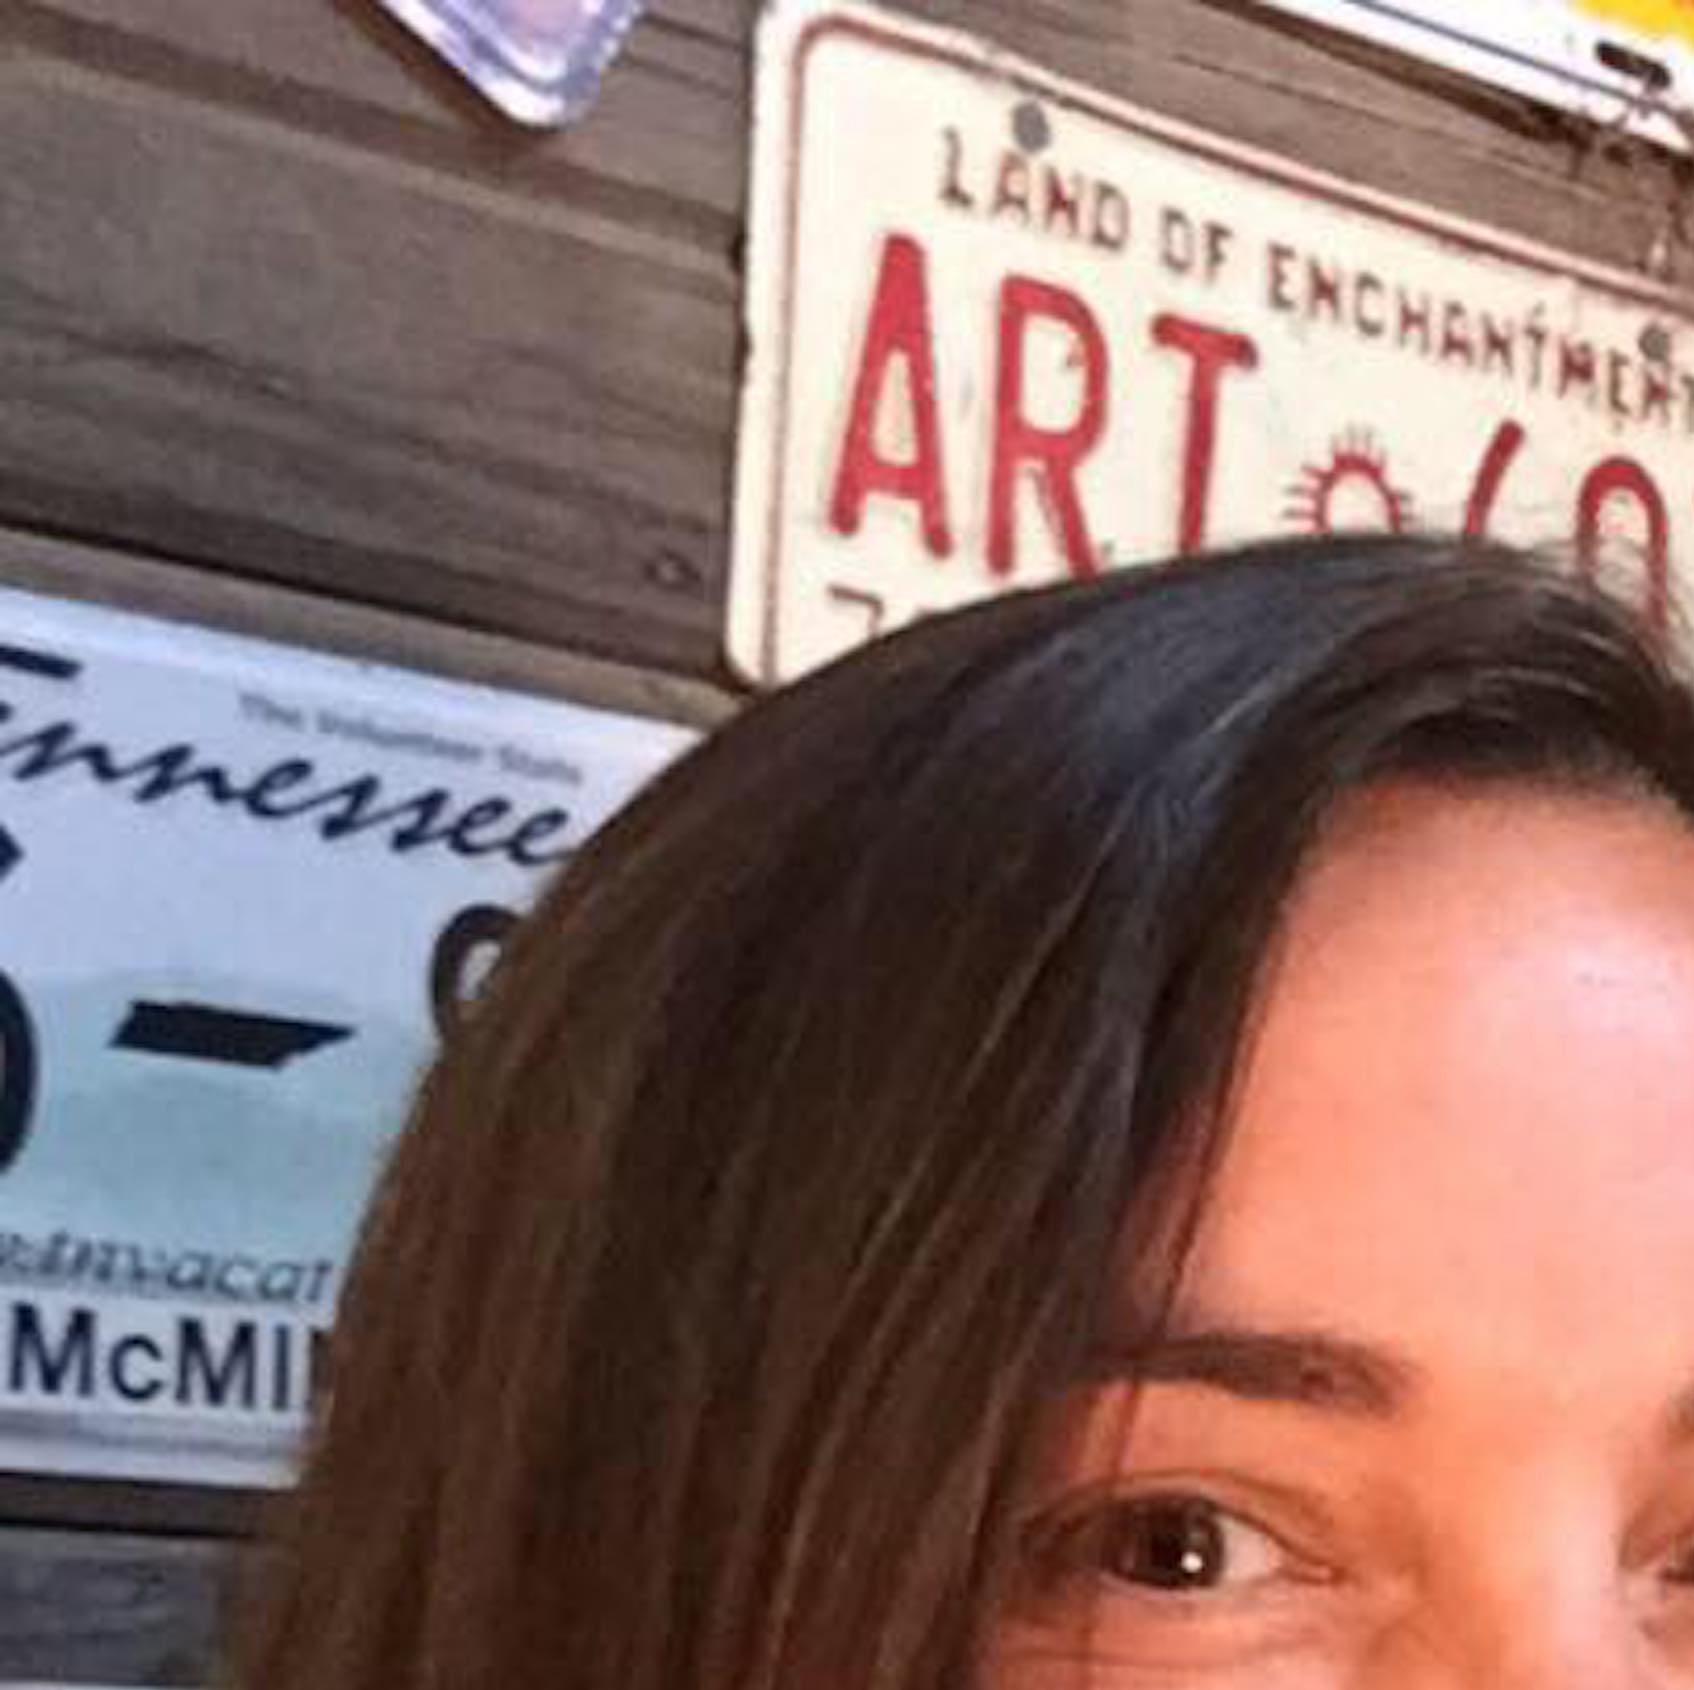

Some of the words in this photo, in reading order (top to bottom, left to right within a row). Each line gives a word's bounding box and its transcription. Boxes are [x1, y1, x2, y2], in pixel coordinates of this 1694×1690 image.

[938, 126, 1130, 254] LAND
[1158, 206, 1234, 286] OF
[826, 232, 1260, 582] ART
[0, 644, 572, 868] nnessee
[8, 1300, 335, 1412] McMI
